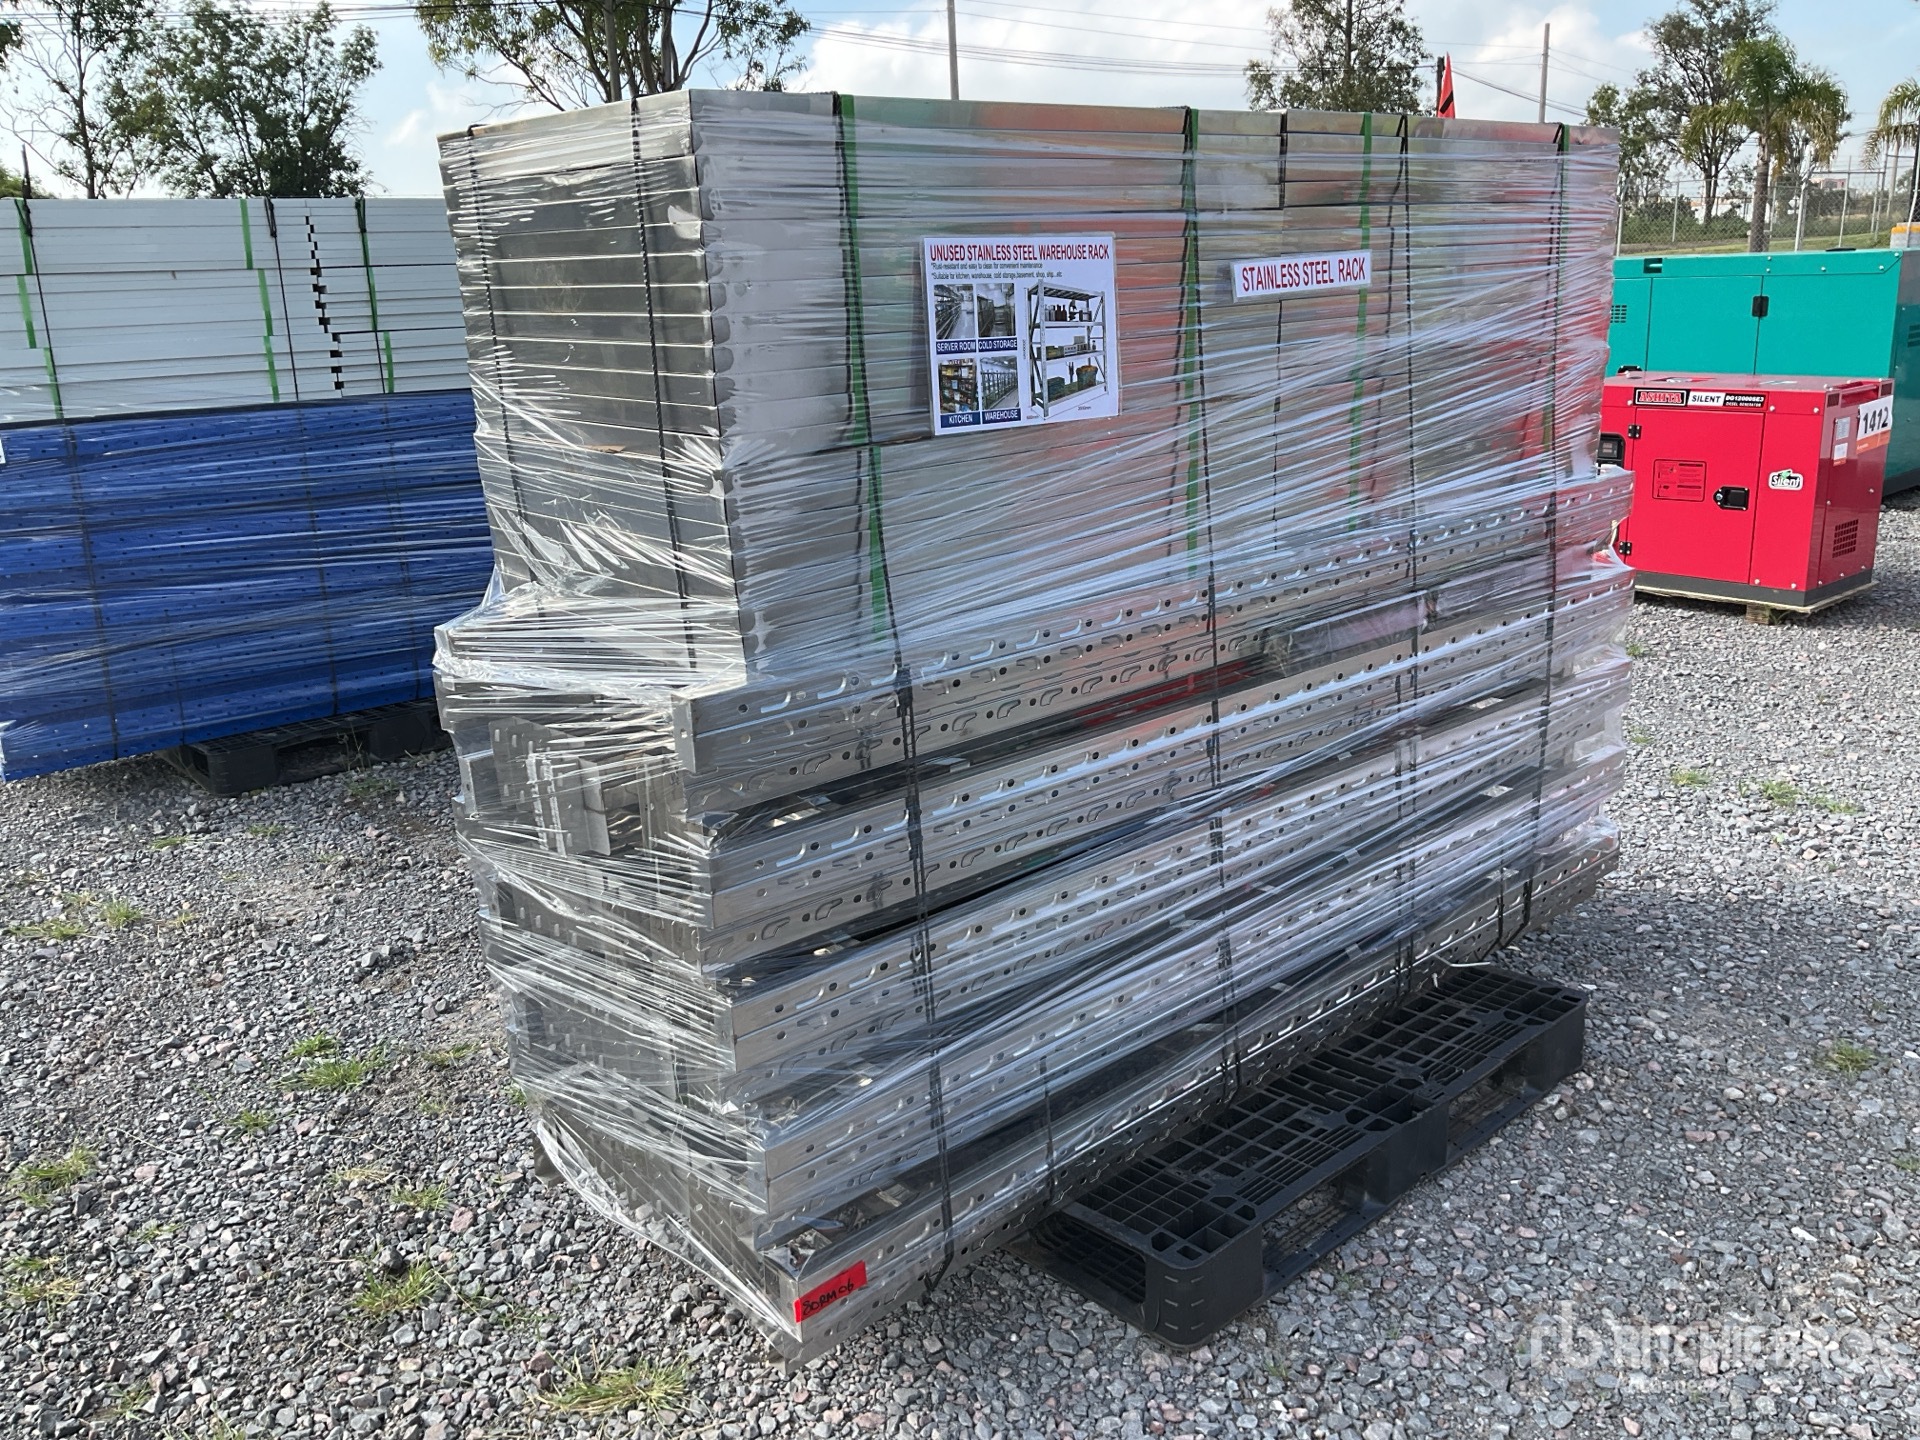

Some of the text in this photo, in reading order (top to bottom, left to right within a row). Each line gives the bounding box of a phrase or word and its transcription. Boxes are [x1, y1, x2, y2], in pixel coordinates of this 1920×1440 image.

[930, 243, 1110, 261] UNUSED STAINLESS STEEL WAREHOUSE RACK
[1242, 256, 1366, 292] STAINLESS STEEL RACK
[937, 341, 976, 352] SERVER ROOM
[978, 339, 1018, 350] COLD STORAGE
[1638, 391, 1722, 404] ASHITA SILENT
[948, 413, 973, 424] KITCHEN
[984, 409, 1018, 420] WAREHOUSE
[1862, 406, 1889, 434] 1412
[1771, 474, 1801, 488] Silent
